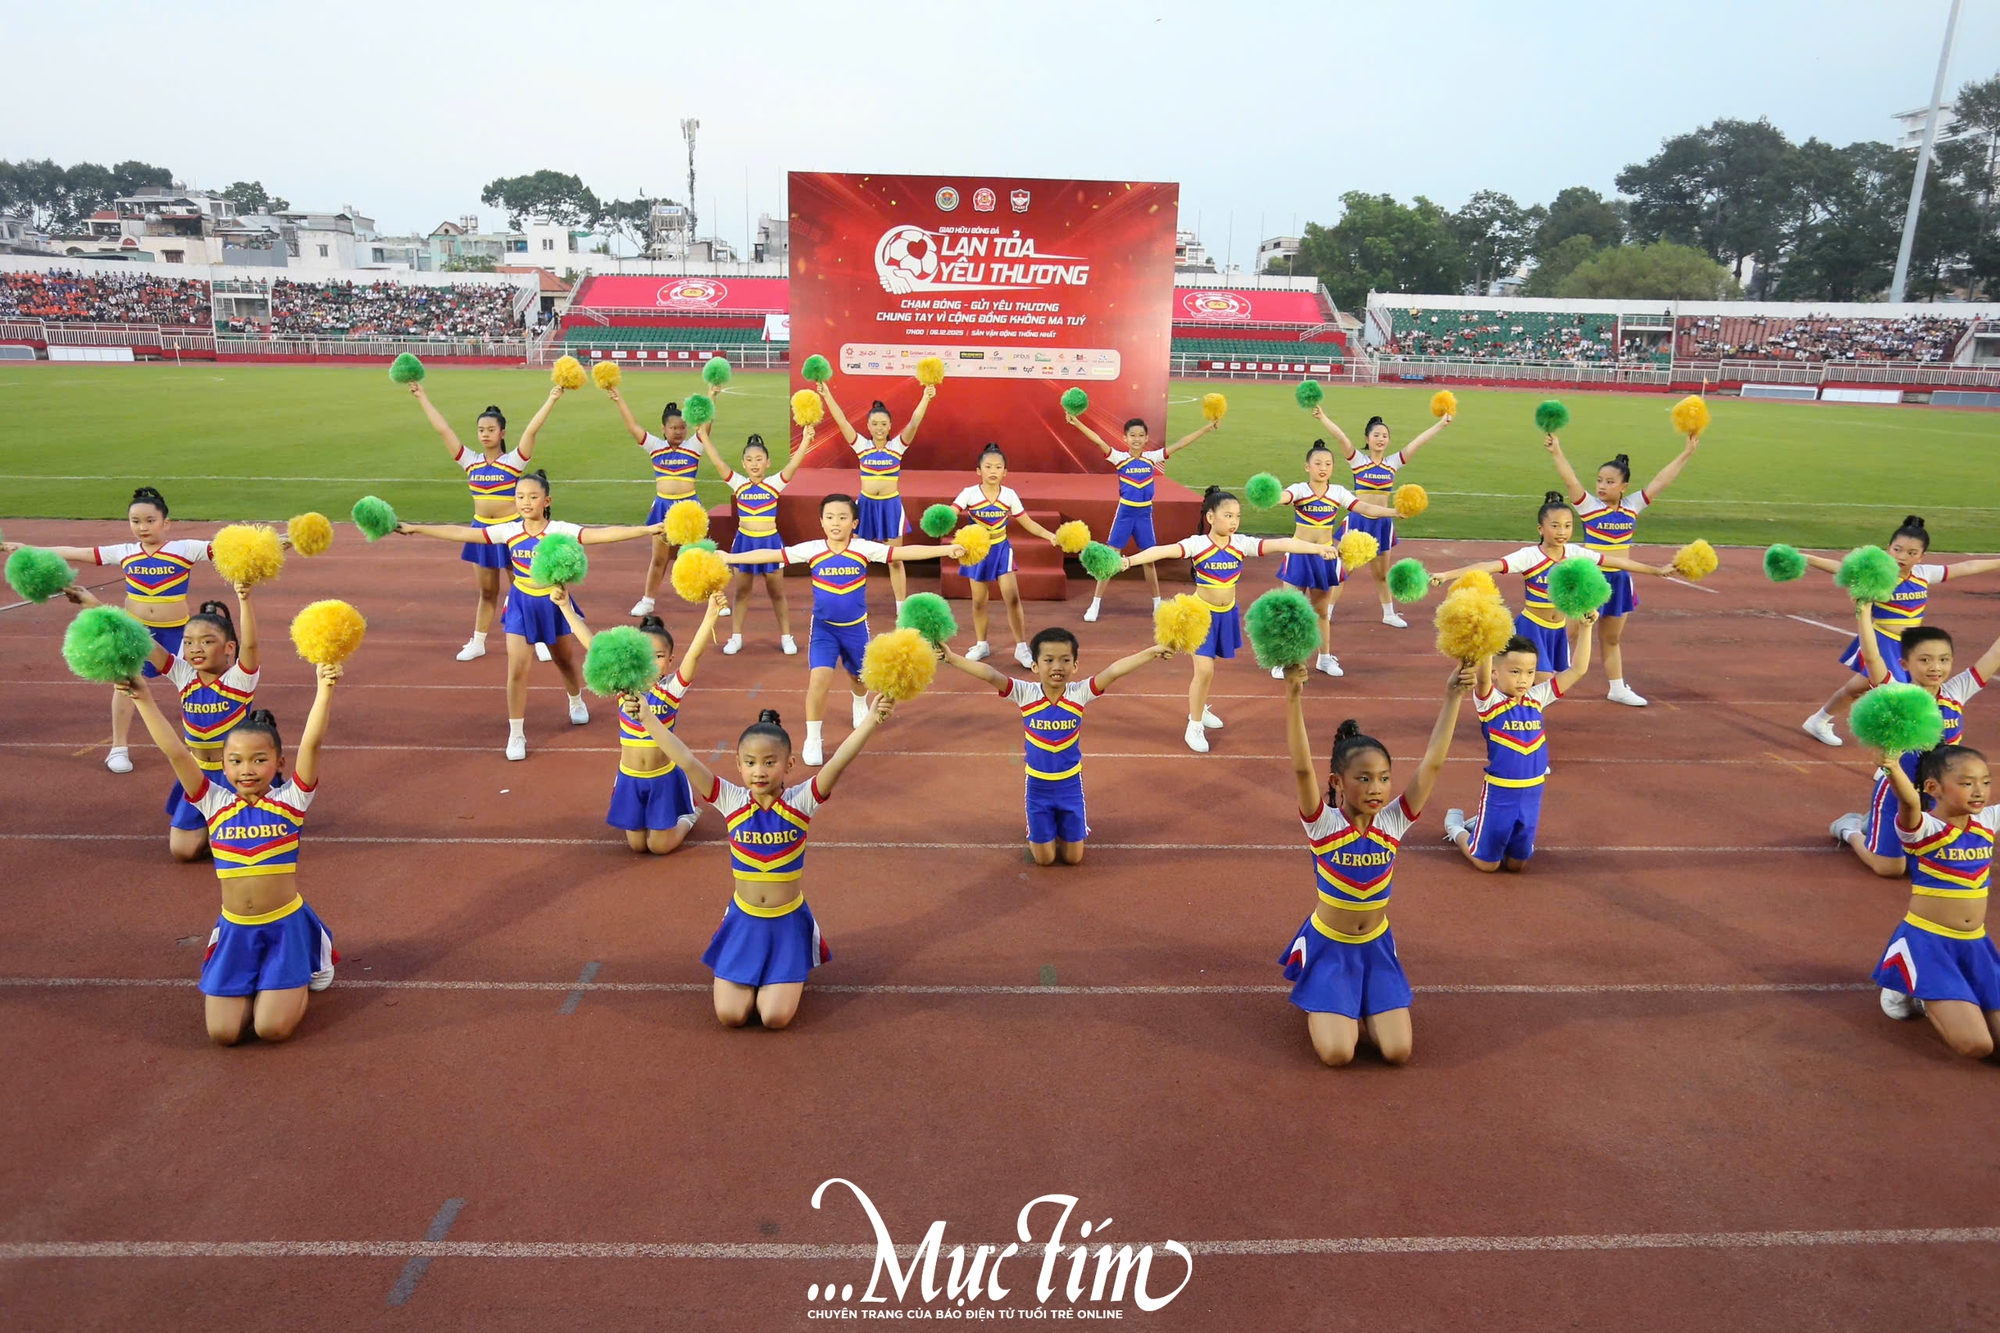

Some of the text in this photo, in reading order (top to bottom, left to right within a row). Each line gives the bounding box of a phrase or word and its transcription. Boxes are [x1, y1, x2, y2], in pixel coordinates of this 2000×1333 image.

[939, 226, 954, 234] GIAO
[971, 226, 990, 235] BÓNG
[941, 230, 1035, 258] LAN TỎA
[940, 256, 1090, 285] YÊU THƯƠNG
[901, 299, 931, 311] CHẠM
[932, 298, 962, 310] BÓNG
[970, 298, 990, 310] GỬI
[992, 299, 1013, 311] YÊU
[1015, 301, 1060, 312] THƯƠNG
[876, 311, 1087, 326] CHUNG TAY VÌ CỘNG ĐỒNG KHÔNG MA TUÝ
[470, 474, 505, 482] AEROBIC
[740, 493, 770, 501] AEROBIC
[975, 510, 1006, 519] AEROBIC
[1302, 505, 1334, 513] AEROBIC
[1597, 522, 1632, 531] AEROBIC
[127, 566, 175, 577] AEROBIC
[818, 567, 860, 577] AEROBIC
[182, 701, 230, 714] AEROBIC
[1029, 718, 1077, 730] AEROBIC
[216, 823, 288, 840] AEROBIC
[733, 829, 798, 845] AEROBIC
[1331, 850, 1391, 867] AEROBIC
